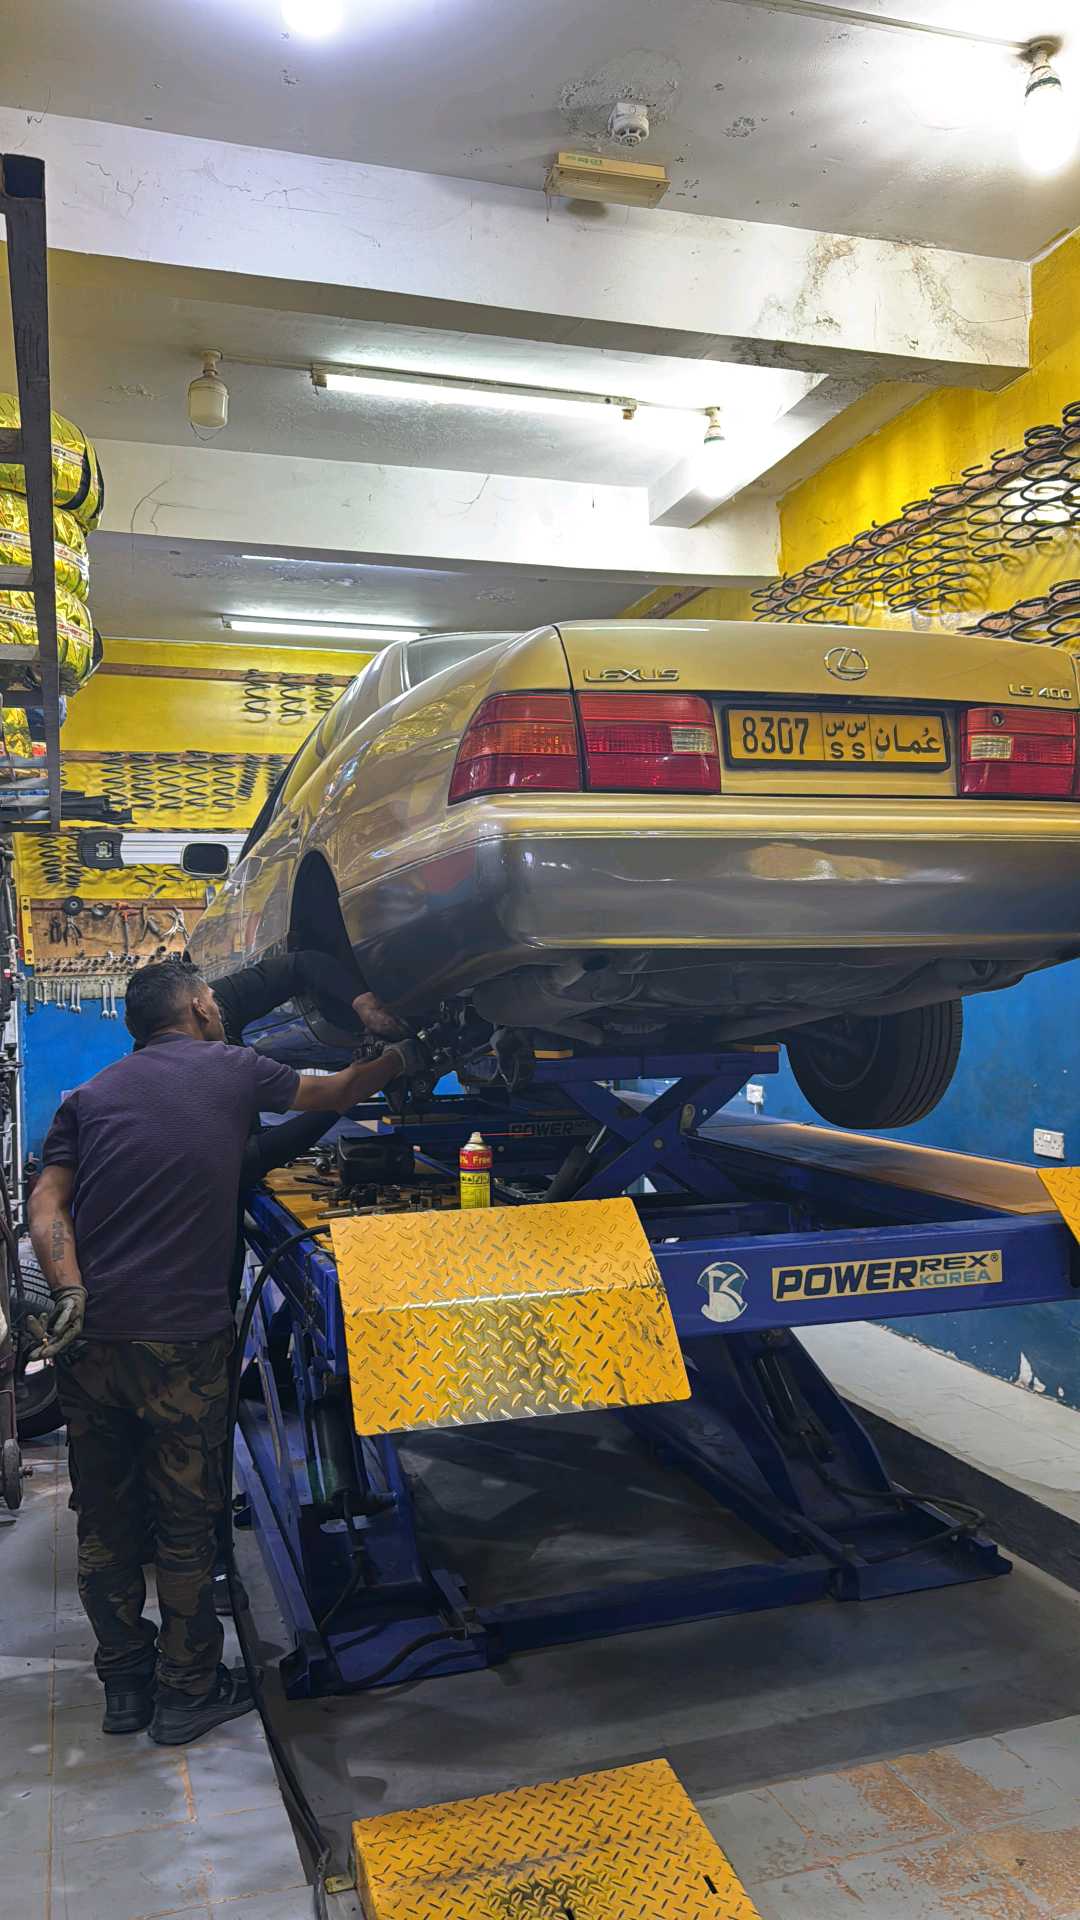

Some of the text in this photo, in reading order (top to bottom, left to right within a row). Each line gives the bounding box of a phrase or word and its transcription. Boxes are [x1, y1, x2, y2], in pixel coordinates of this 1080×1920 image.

[583, 668, 680, 682] LEXUS
[1008, 683, 1072, 701] LS 400
[742, 716, 809, 755] 8307
[920, 1269, 992, 1286] KOREA
